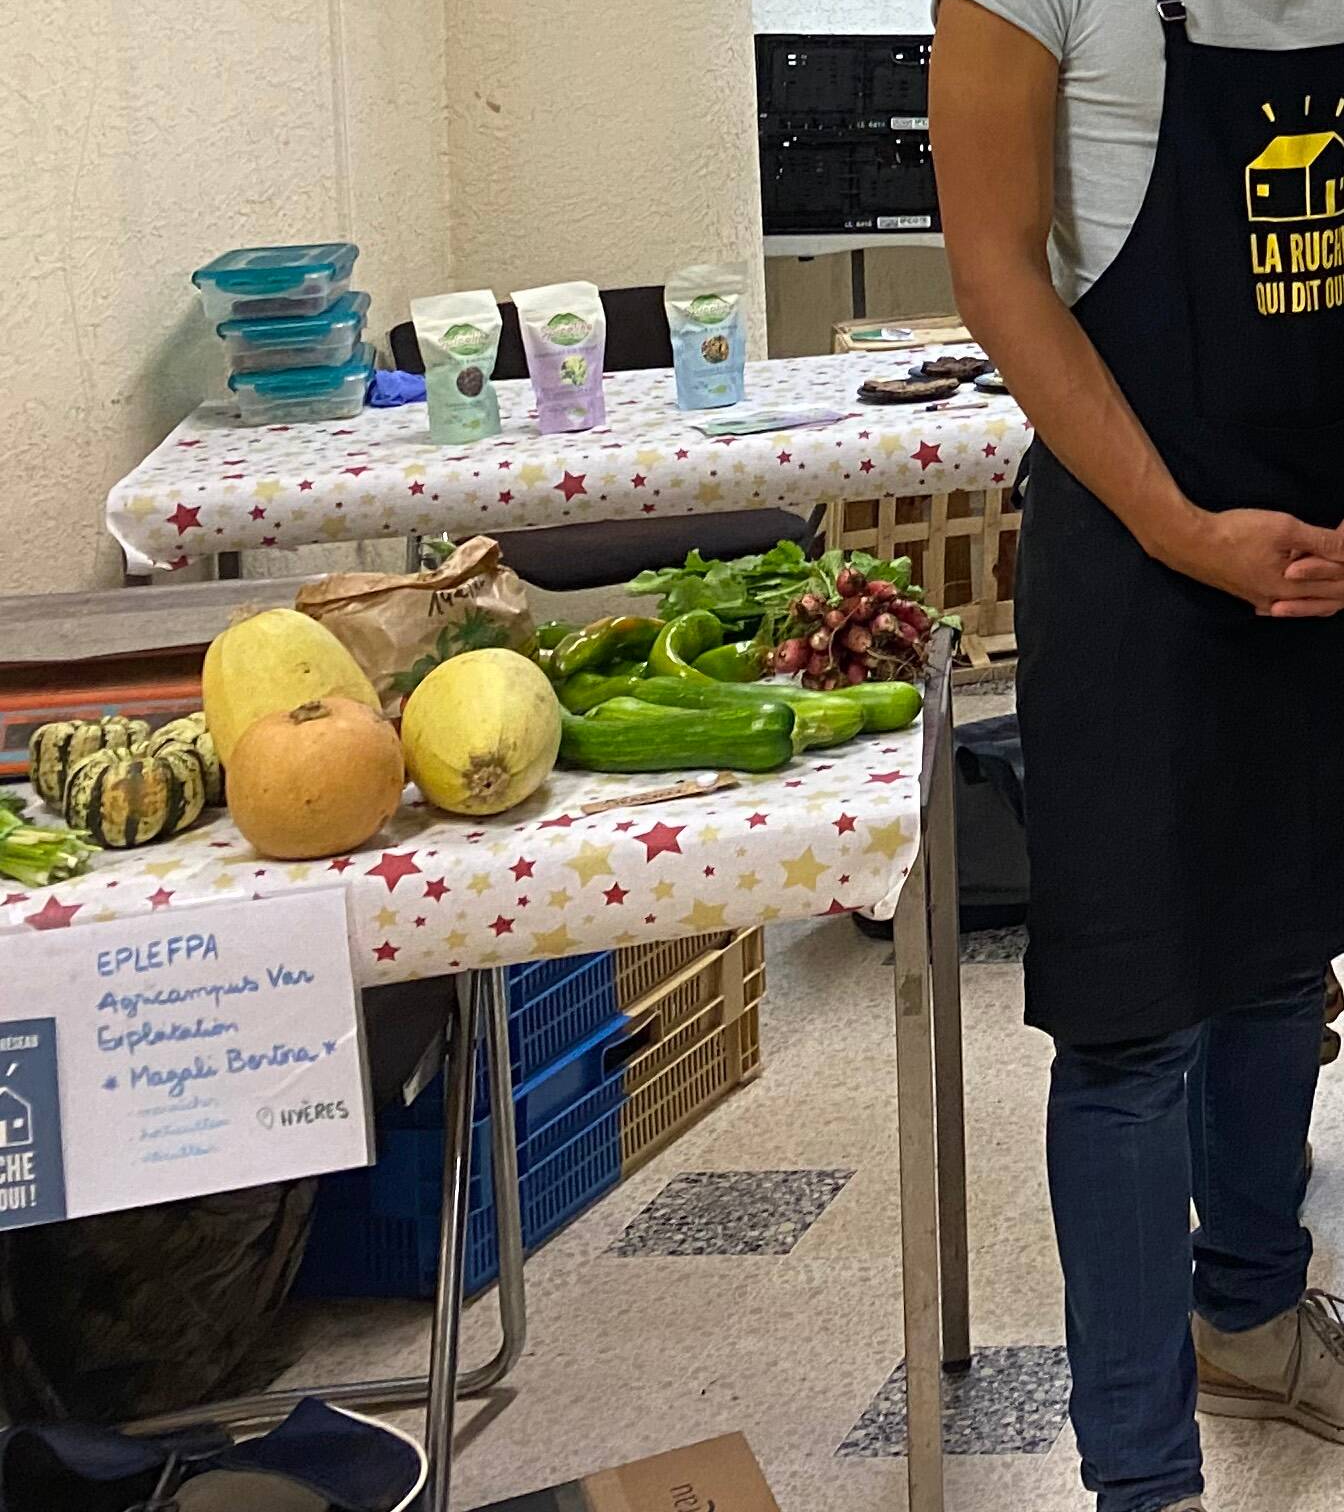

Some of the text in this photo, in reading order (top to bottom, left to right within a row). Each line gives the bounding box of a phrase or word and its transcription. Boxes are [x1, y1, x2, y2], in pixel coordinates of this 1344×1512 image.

[1250, 233, 1282, 274] LA
[1255, 282, 1286, 315] QUI
[1292, 278, 1320, 313] DIT
[97, 933, 219, 976] EPLEFPA
